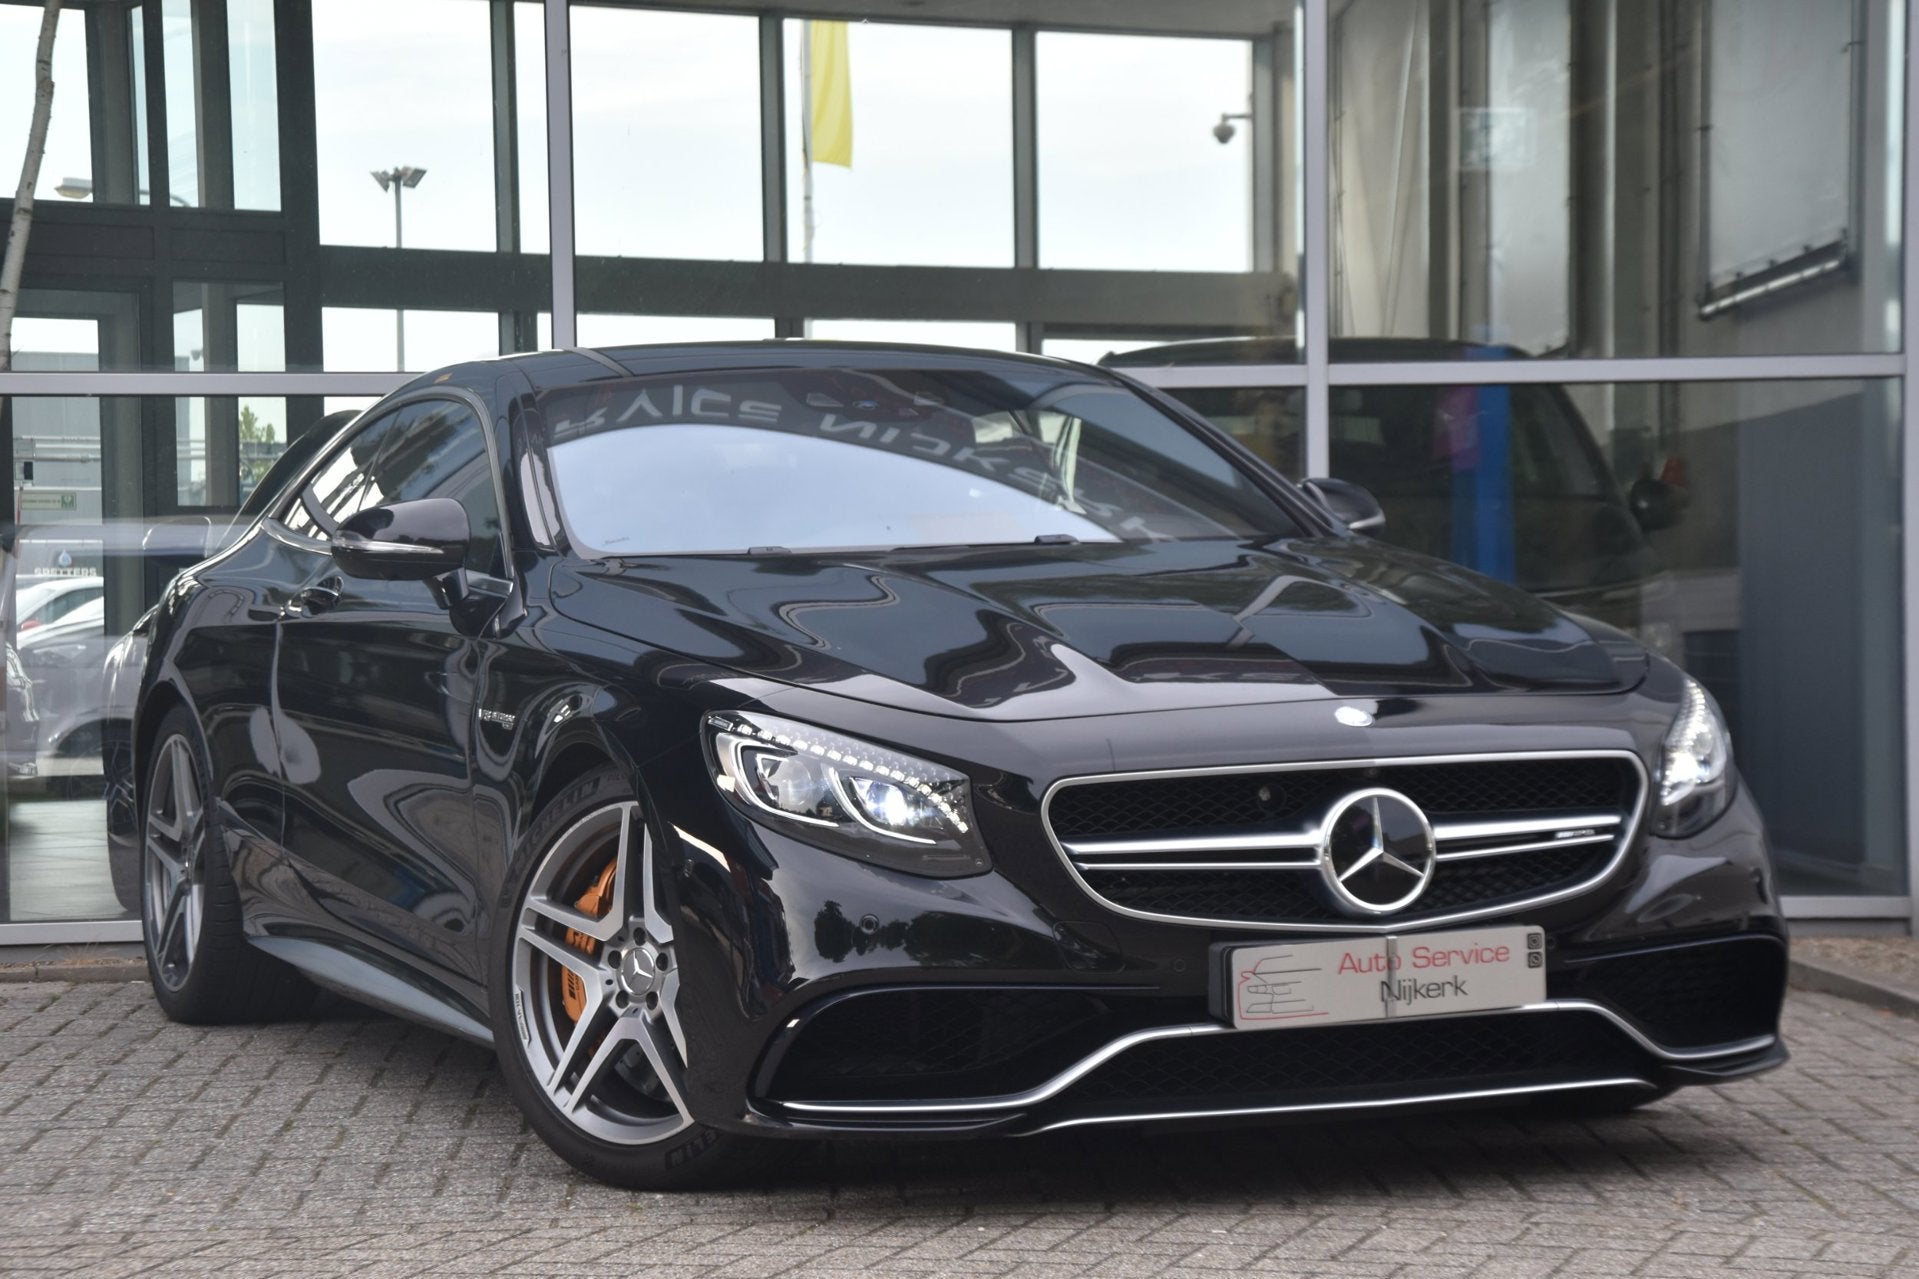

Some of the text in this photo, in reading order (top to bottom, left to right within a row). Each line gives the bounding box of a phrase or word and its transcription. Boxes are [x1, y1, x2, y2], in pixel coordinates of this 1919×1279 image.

[1337, 942, 1511, 975] Auto Service
[1379, 974, 1469, 1006] Nijkerk
